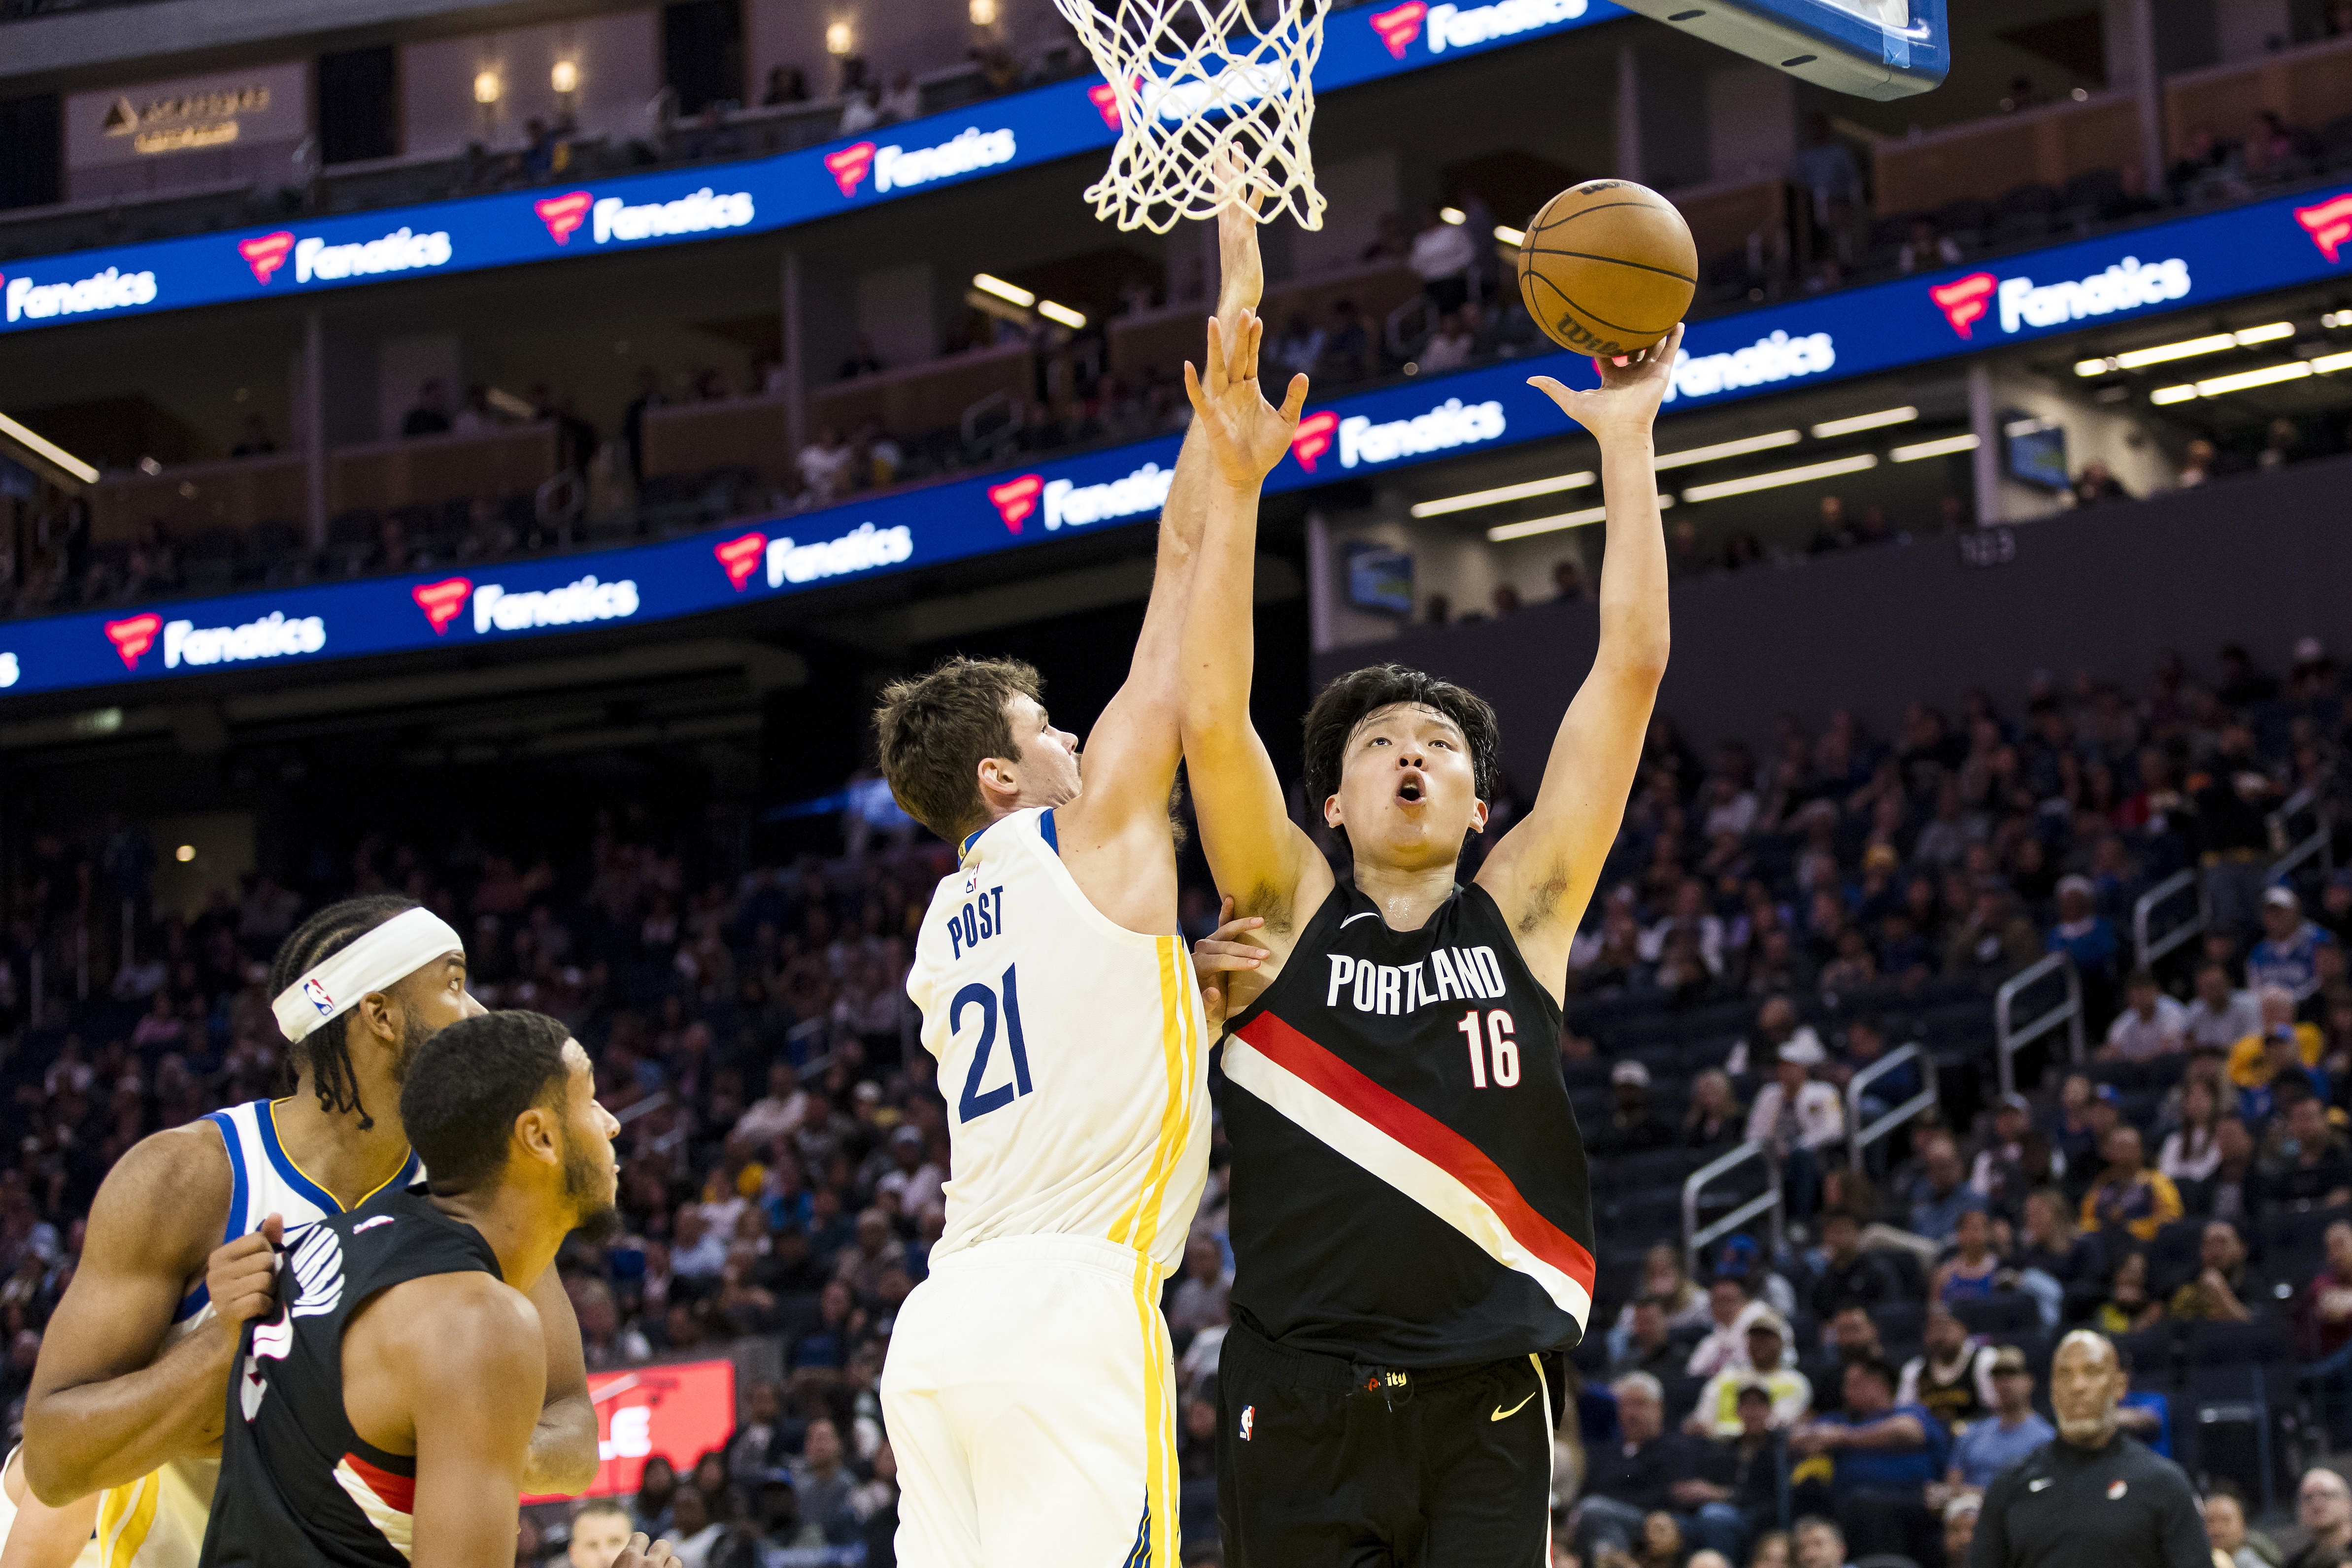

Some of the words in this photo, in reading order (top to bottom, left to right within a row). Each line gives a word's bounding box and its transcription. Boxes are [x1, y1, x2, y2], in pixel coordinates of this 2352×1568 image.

[874, 127, 1016, 192] Fanatics
[593, 188, 754, 243] Fanatics
[296, 227, 452, 283] Fanatics
[6, 266, 157, 322] Fanatics
[1998, 257, 2191, 333] Fanatics
[1339, 398, 1506, 467] Fanatics
[1043, 462, 1175, 531] Fanatic
[766, 522, 913, 587] Fanatics
[473, 575, 639, 634] Fanatics
[164, 611, 325, 668] Fanatics
[947, 885, 1003, 960] POST
[1326, 946, 1506, 1015] PORTLAND
[949, 962, 1033, 1124] 21
[1458, 1008, 1521, 1089] 16
[1378, 1372, 1407, 1387] ity
